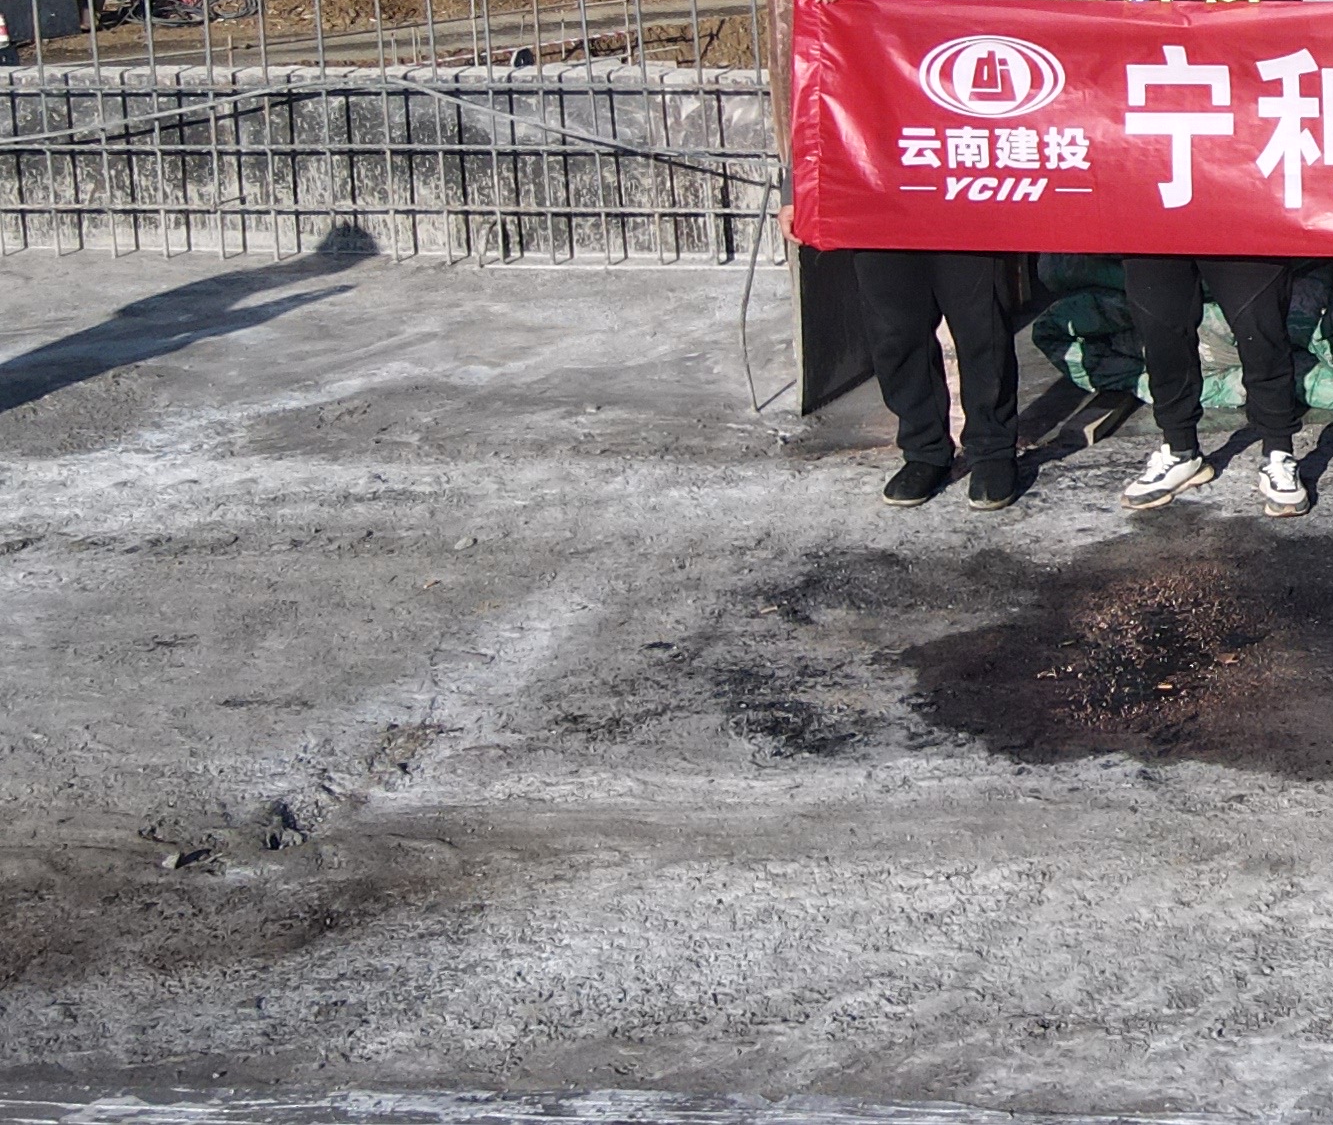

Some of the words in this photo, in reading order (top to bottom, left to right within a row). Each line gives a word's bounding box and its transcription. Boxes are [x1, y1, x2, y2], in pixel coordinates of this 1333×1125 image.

[898, 126, 1091, 170] 云南建投
[944, 177, 1048, 202] YCIH
